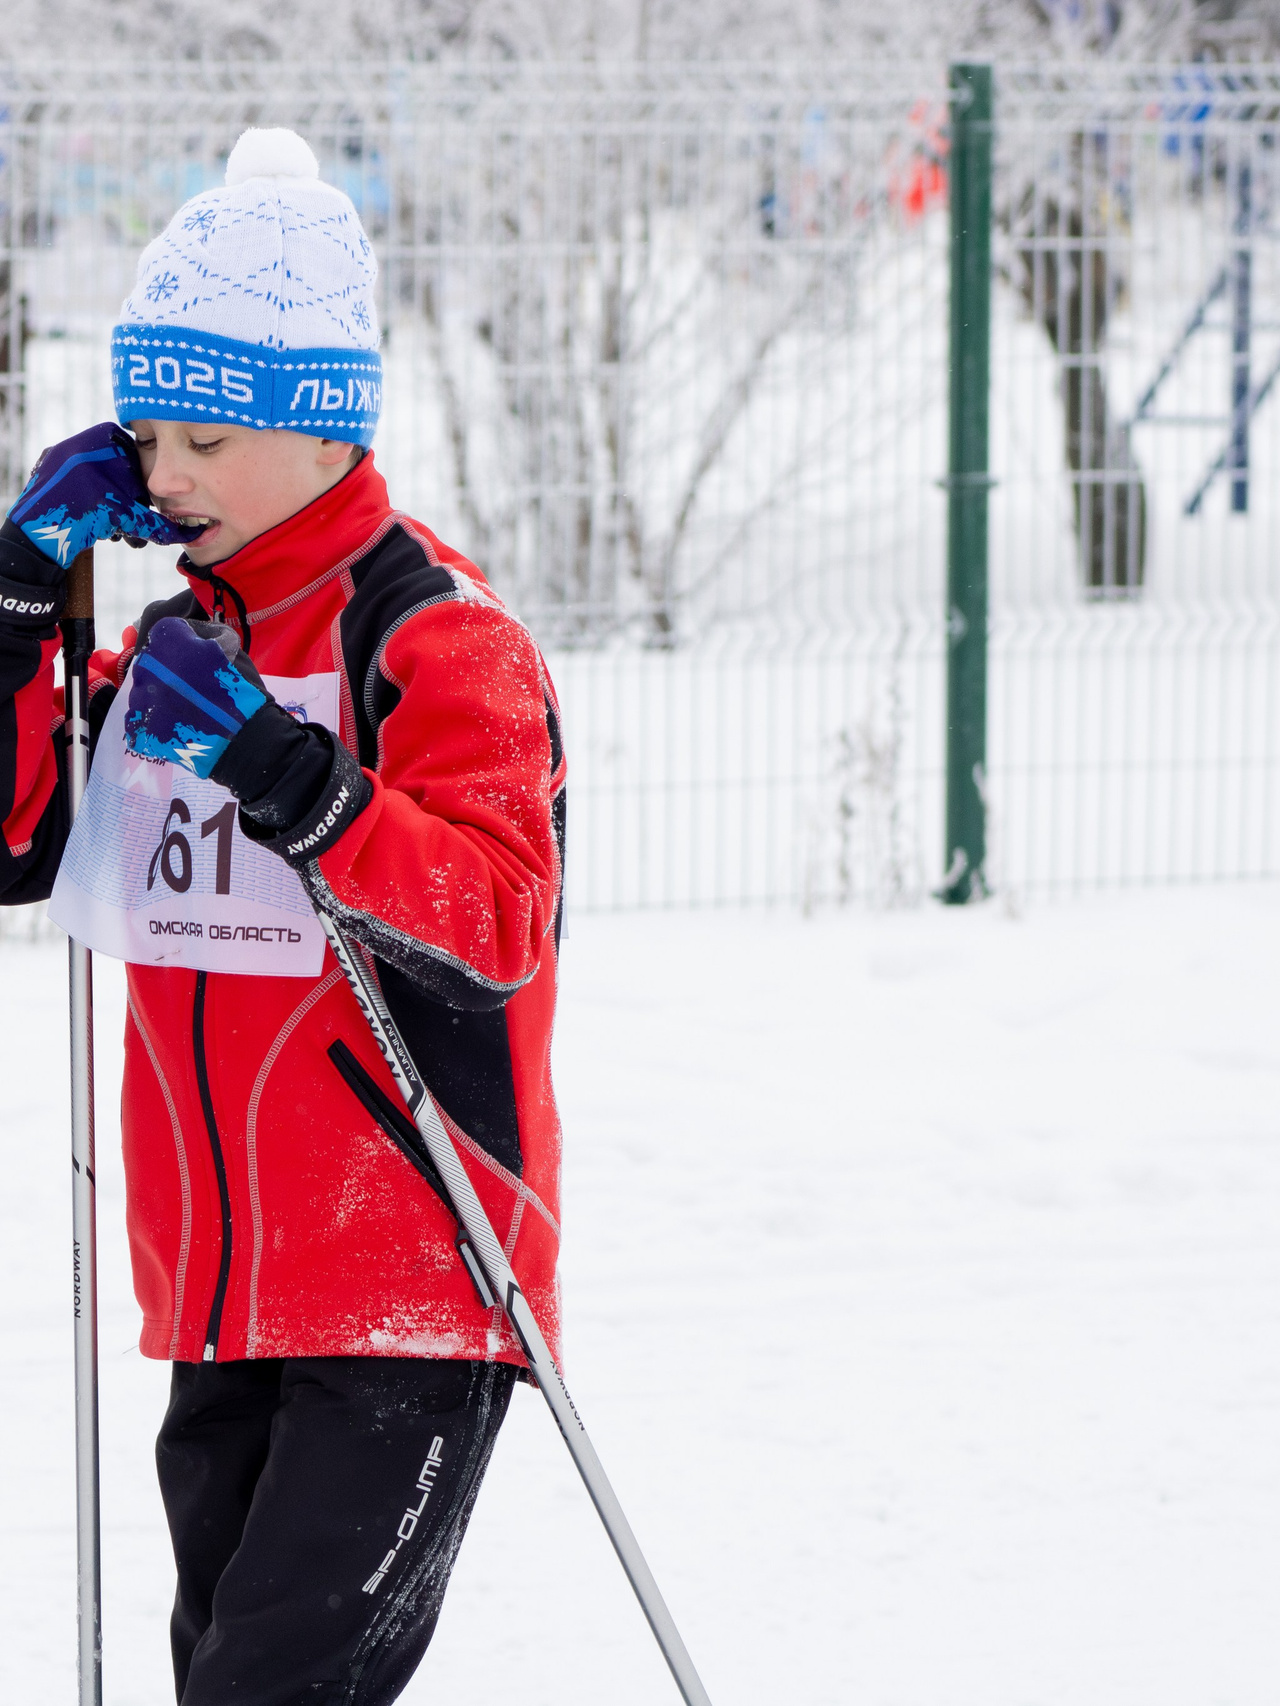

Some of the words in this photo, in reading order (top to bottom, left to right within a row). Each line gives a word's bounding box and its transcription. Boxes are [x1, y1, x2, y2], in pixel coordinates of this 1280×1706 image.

[129, 354, 254, 404] 2025
[287, 785, 350, 855] NORDWAY
[149, 920, 203, 938] ОМСКАЯ
[209, 924, 302, 943] ОБЛАСТЬ
[385, 1023, 418, 1083] ALUMINIUM
[73, 1238, 81, 1319] NORDWAY
[361, 1435, 444, 1595] SP-OLIMP
